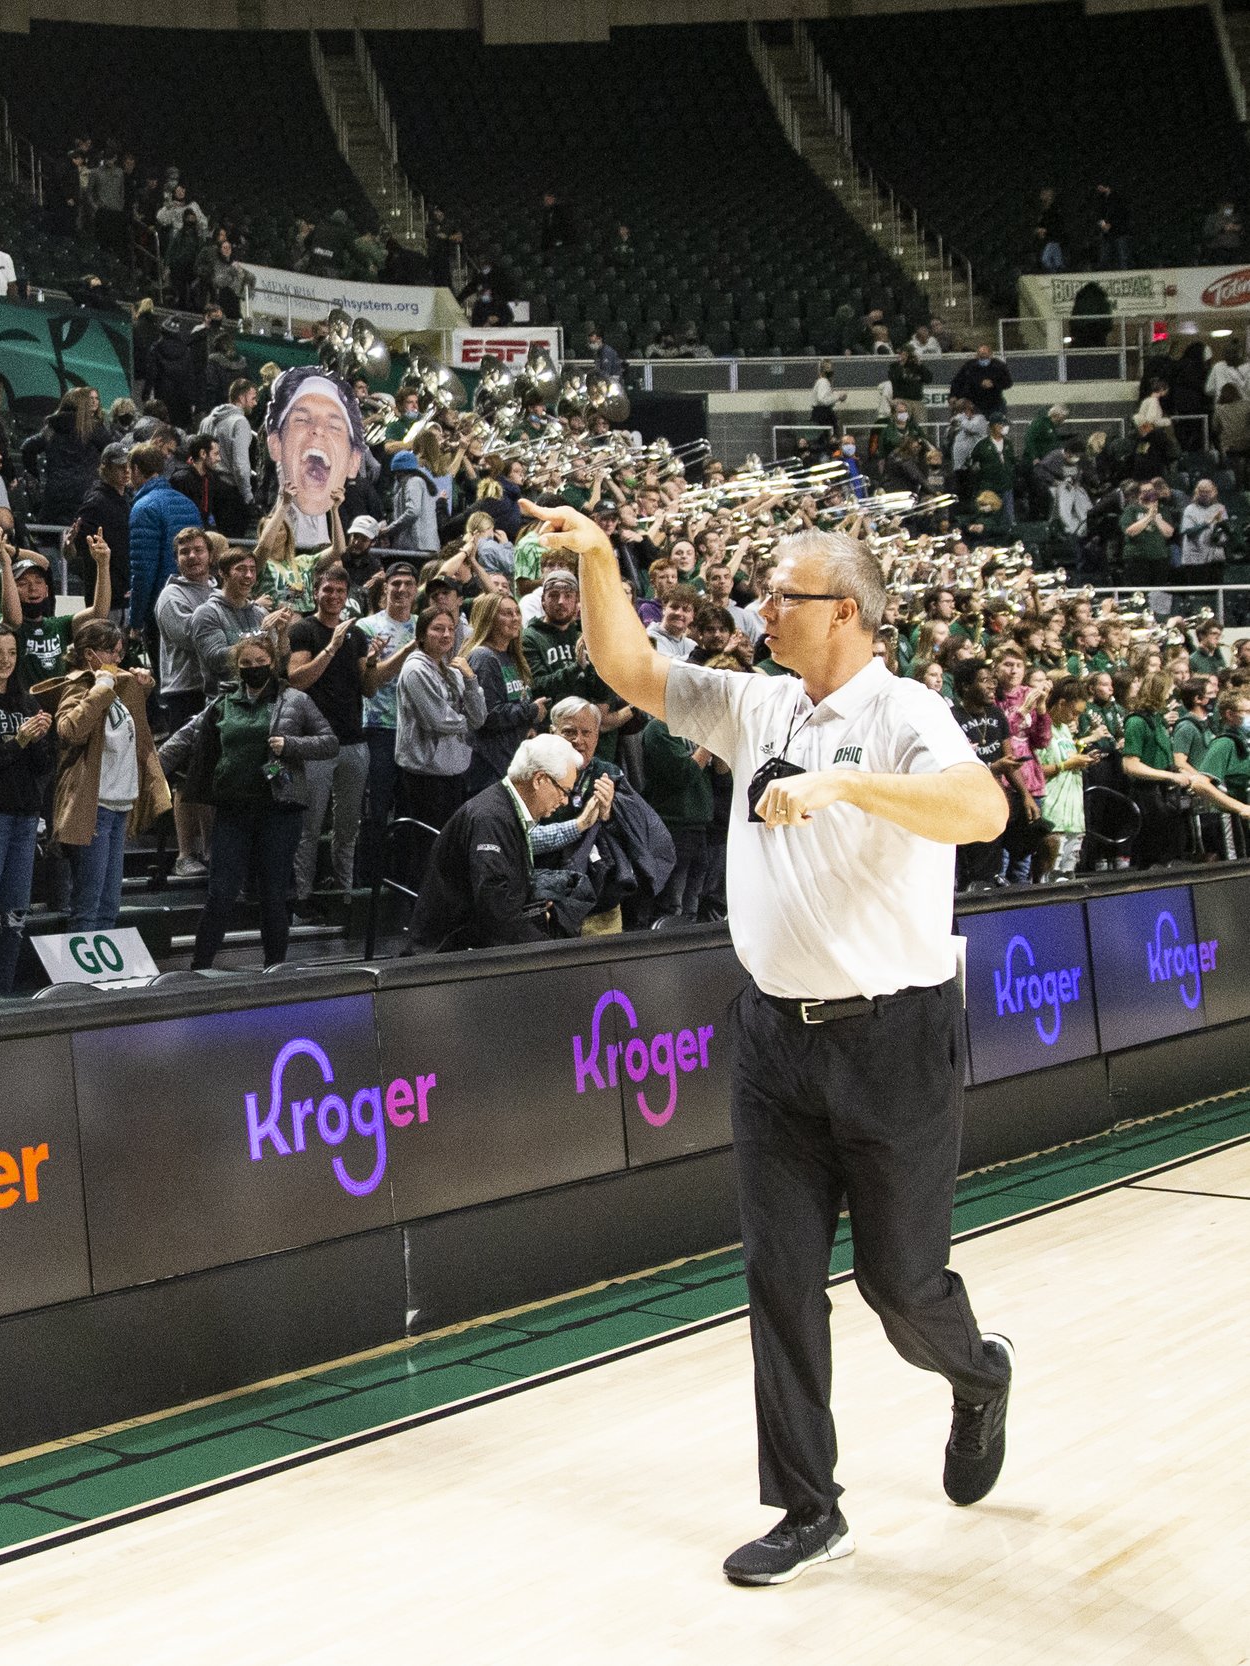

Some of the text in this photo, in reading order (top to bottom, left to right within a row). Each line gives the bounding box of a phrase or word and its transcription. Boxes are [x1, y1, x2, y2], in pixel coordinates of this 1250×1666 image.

[833, 745, 863, 765] OHIO
[69, 934, 125, 975] GO
[993, 934, 1082, 1045] Kroger
[1146, 911, 1219, 1009] Kroger
[572, 989, 714, 1127] Kroger
[244, 1037, 437, 1196] Kroger
